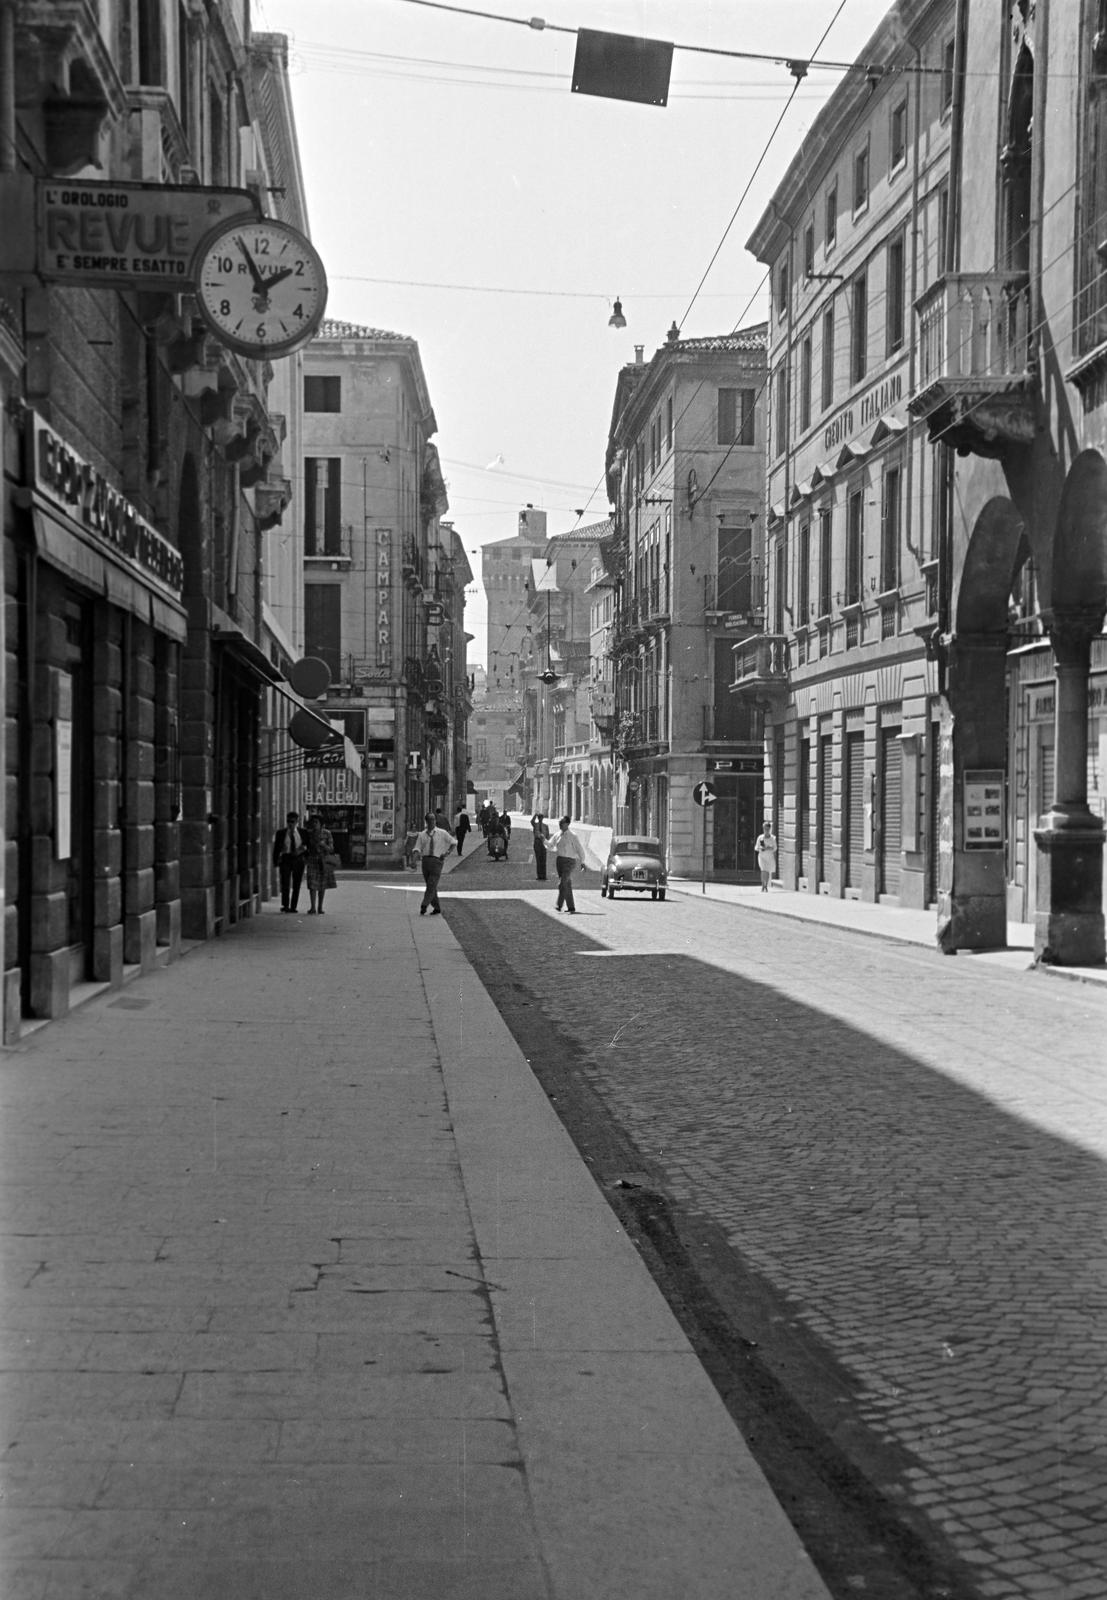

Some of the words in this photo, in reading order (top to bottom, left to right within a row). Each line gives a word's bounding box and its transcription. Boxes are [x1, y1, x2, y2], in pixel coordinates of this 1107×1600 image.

[61, 190, 129, 208] OROLOGIO
[47, 210, 190, 256] REVUE
[254, 238, 270, 255] 12
[73, 255, 127, 271] SEMPRE
[132, 257, 186, 274] ESATTO
[217, 256, 233, 273] 10
[294, 260, 304, 277] 2
[220, 299, 231, 316] 8
[292, 303, 303, 319] 4
[255, 322, 266, 338] 6
[824, 410, 854, 452] CREDITO
[861, 374, 902, 427] ITALIANO
[377, 531, 390, 664] CAMPARI
[305, 791, 359, 801] BACCHI
